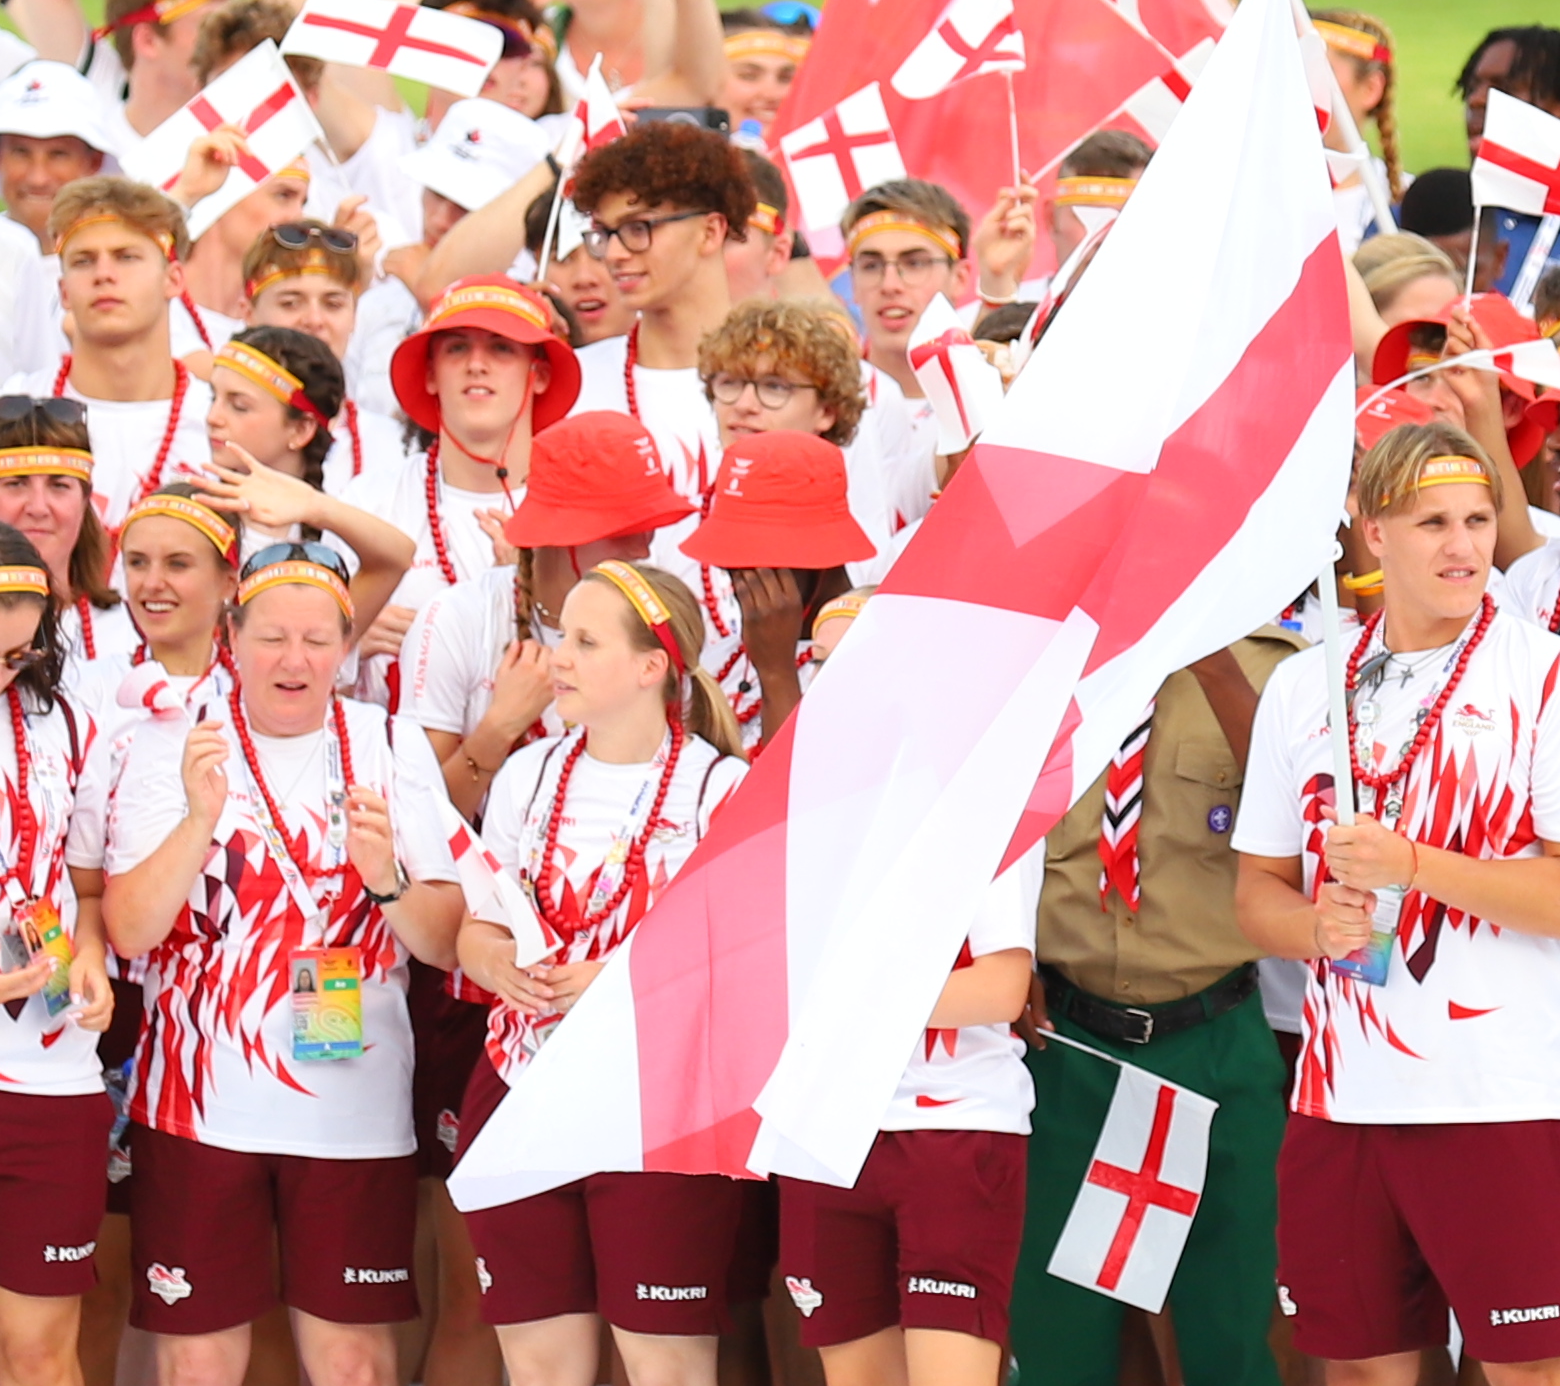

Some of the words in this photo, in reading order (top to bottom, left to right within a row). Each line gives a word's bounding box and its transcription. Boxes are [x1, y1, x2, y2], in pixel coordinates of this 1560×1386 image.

[358, 1268, 409, 1284] KUKRI
[650, 1285, 707, 1301] KUKRI
[919, 1278, 976, 1299] KUKRI
[1503, 1305, 1560, 1324] KUKRI
